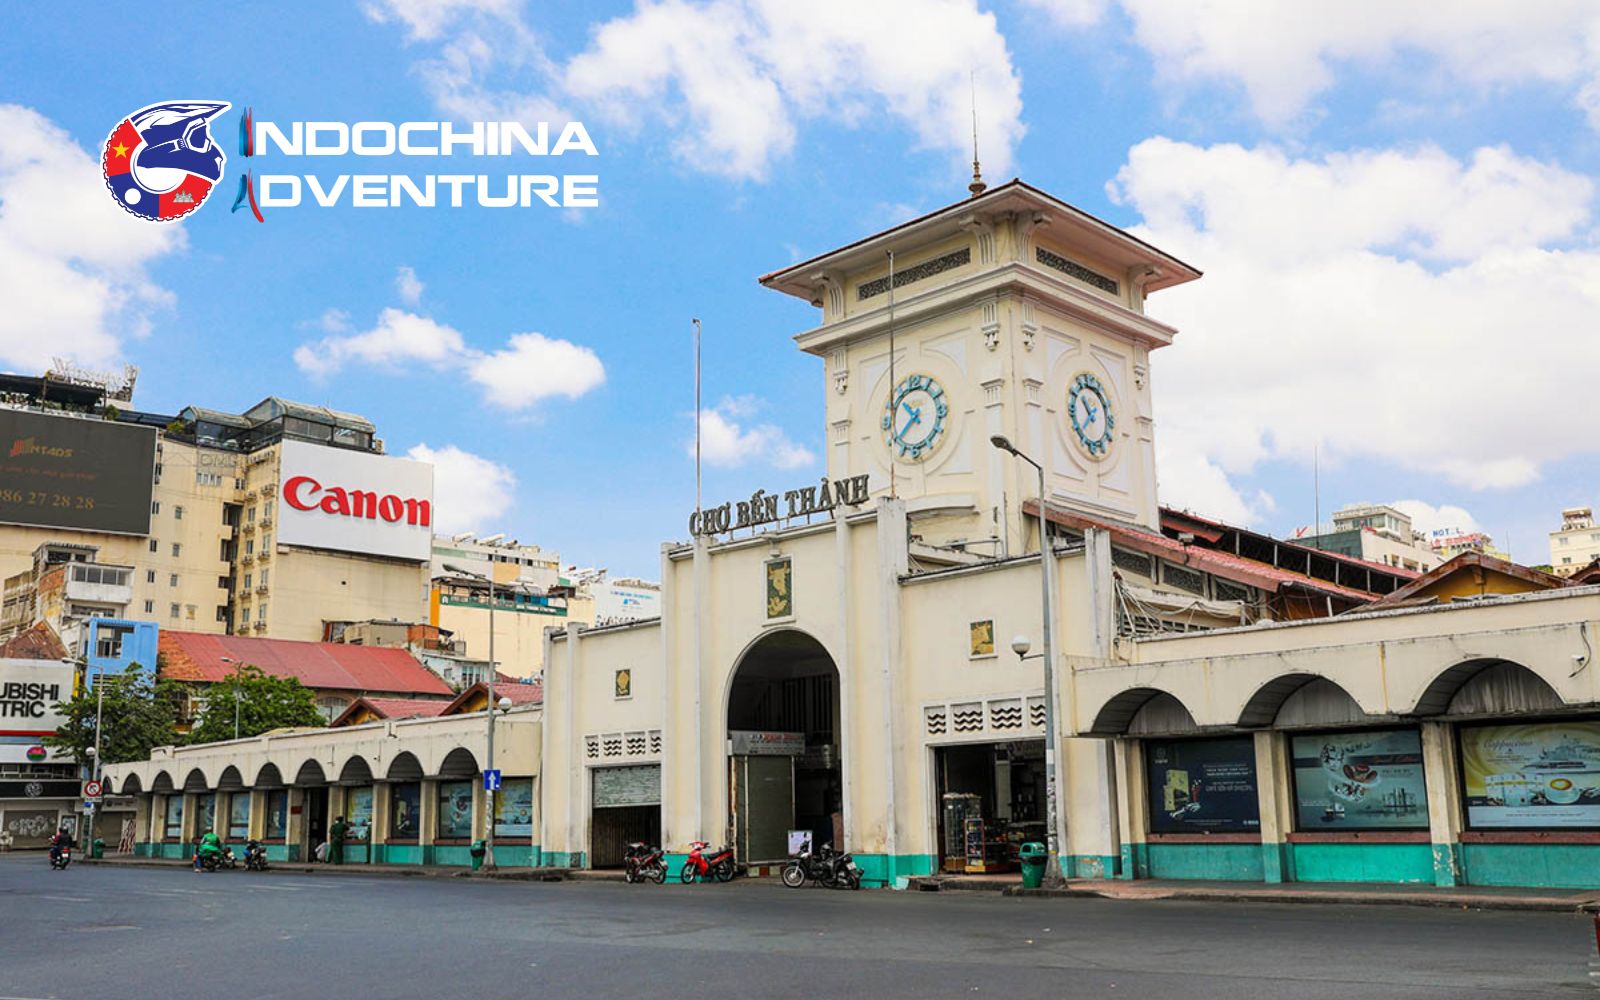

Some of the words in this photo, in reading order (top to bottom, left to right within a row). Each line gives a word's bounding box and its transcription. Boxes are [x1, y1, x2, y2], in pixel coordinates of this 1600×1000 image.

[52, 494, 70, 507] 28
[74, 495, 95, 510] 28
[283, 476, 430, 527] Canon
[689, 502, 732, 537] CHỢ
[736, 489, 779, 528] BẾN
[0, 700, 45, 718] TRIC
